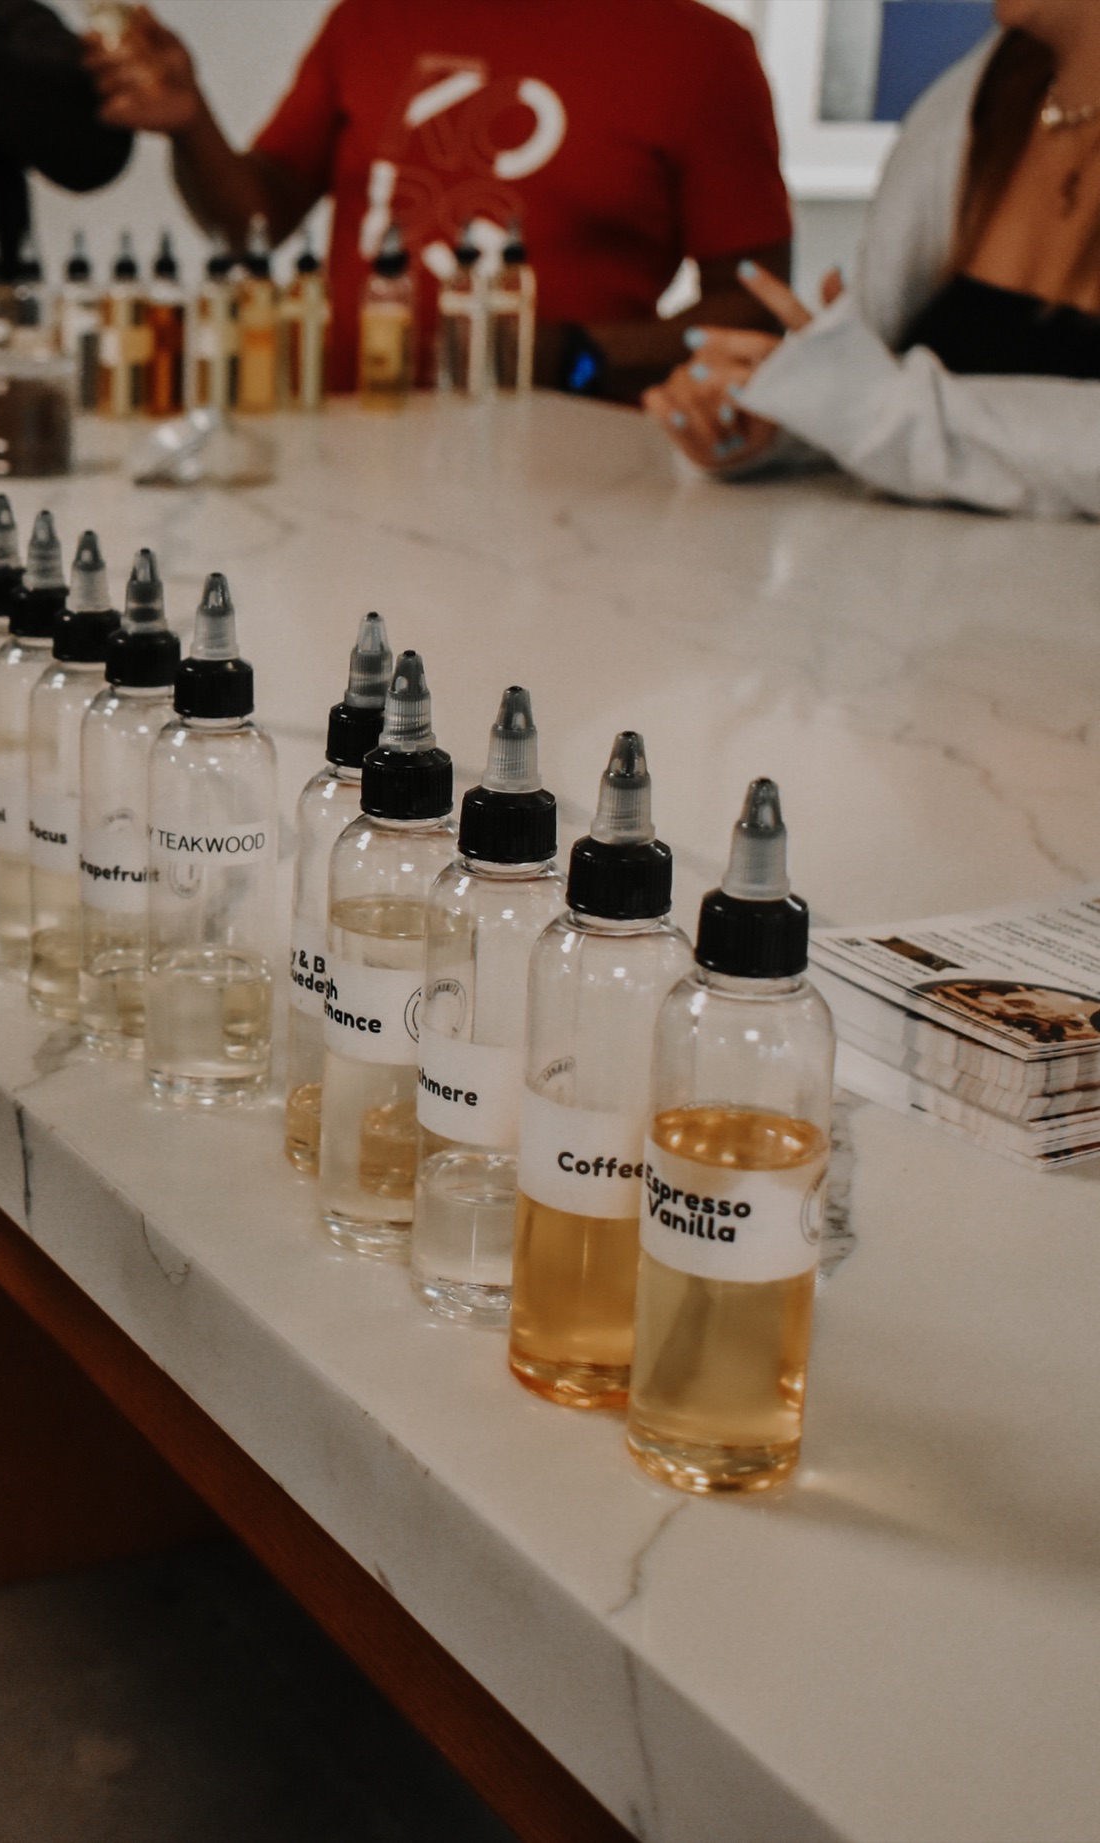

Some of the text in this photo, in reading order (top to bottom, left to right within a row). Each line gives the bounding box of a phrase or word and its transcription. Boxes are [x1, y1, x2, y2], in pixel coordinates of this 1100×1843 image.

[157, 829, 266, 853] TEAKWOOD
[80, 854, 159, 882] rapefruit
[557, 1151, 644, 1178] Coffee
[645, 1163, 751, 1218] Espresso
[648, 1192, 736, 1243] Vanilla
